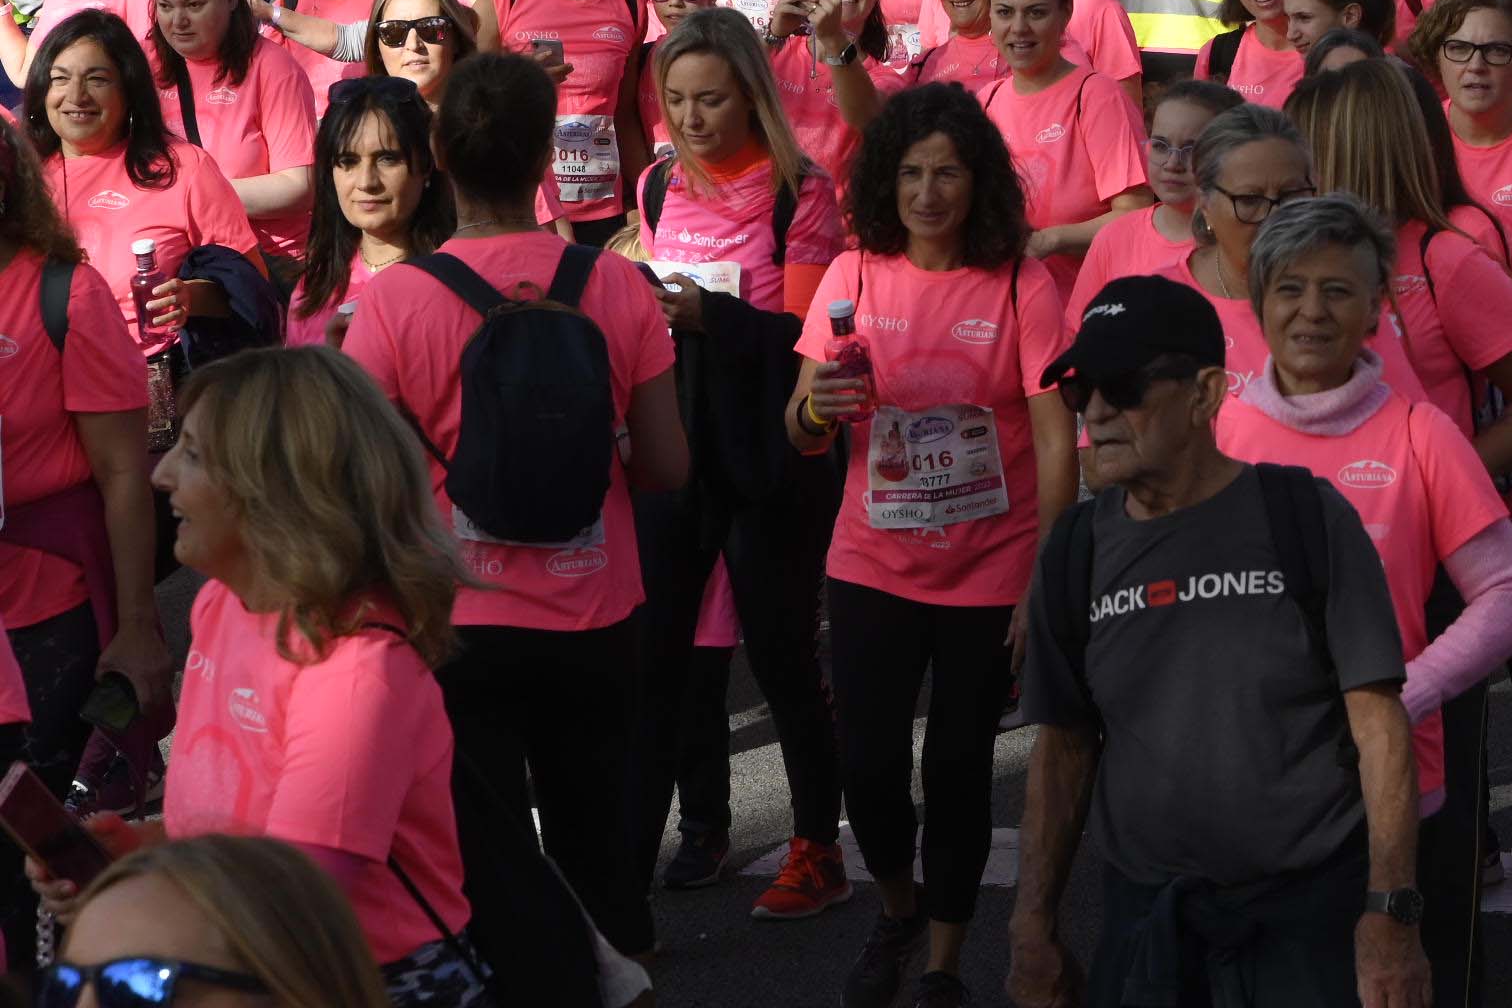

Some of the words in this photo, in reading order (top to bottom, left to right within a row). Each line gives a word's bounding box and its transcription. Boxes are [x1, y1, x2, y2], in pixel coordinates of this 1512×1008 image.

[751, 17, 764, 26] 16
[552, 149, 589, 161] 016
[562, 165, 586, 173] 11048
[956, 497, 997, 513] Santander
[882, 509, 923, 521] OYSHO
[1089, 585, 1146, 622] JACK
[1179, 570, 1285, 602] JONES
